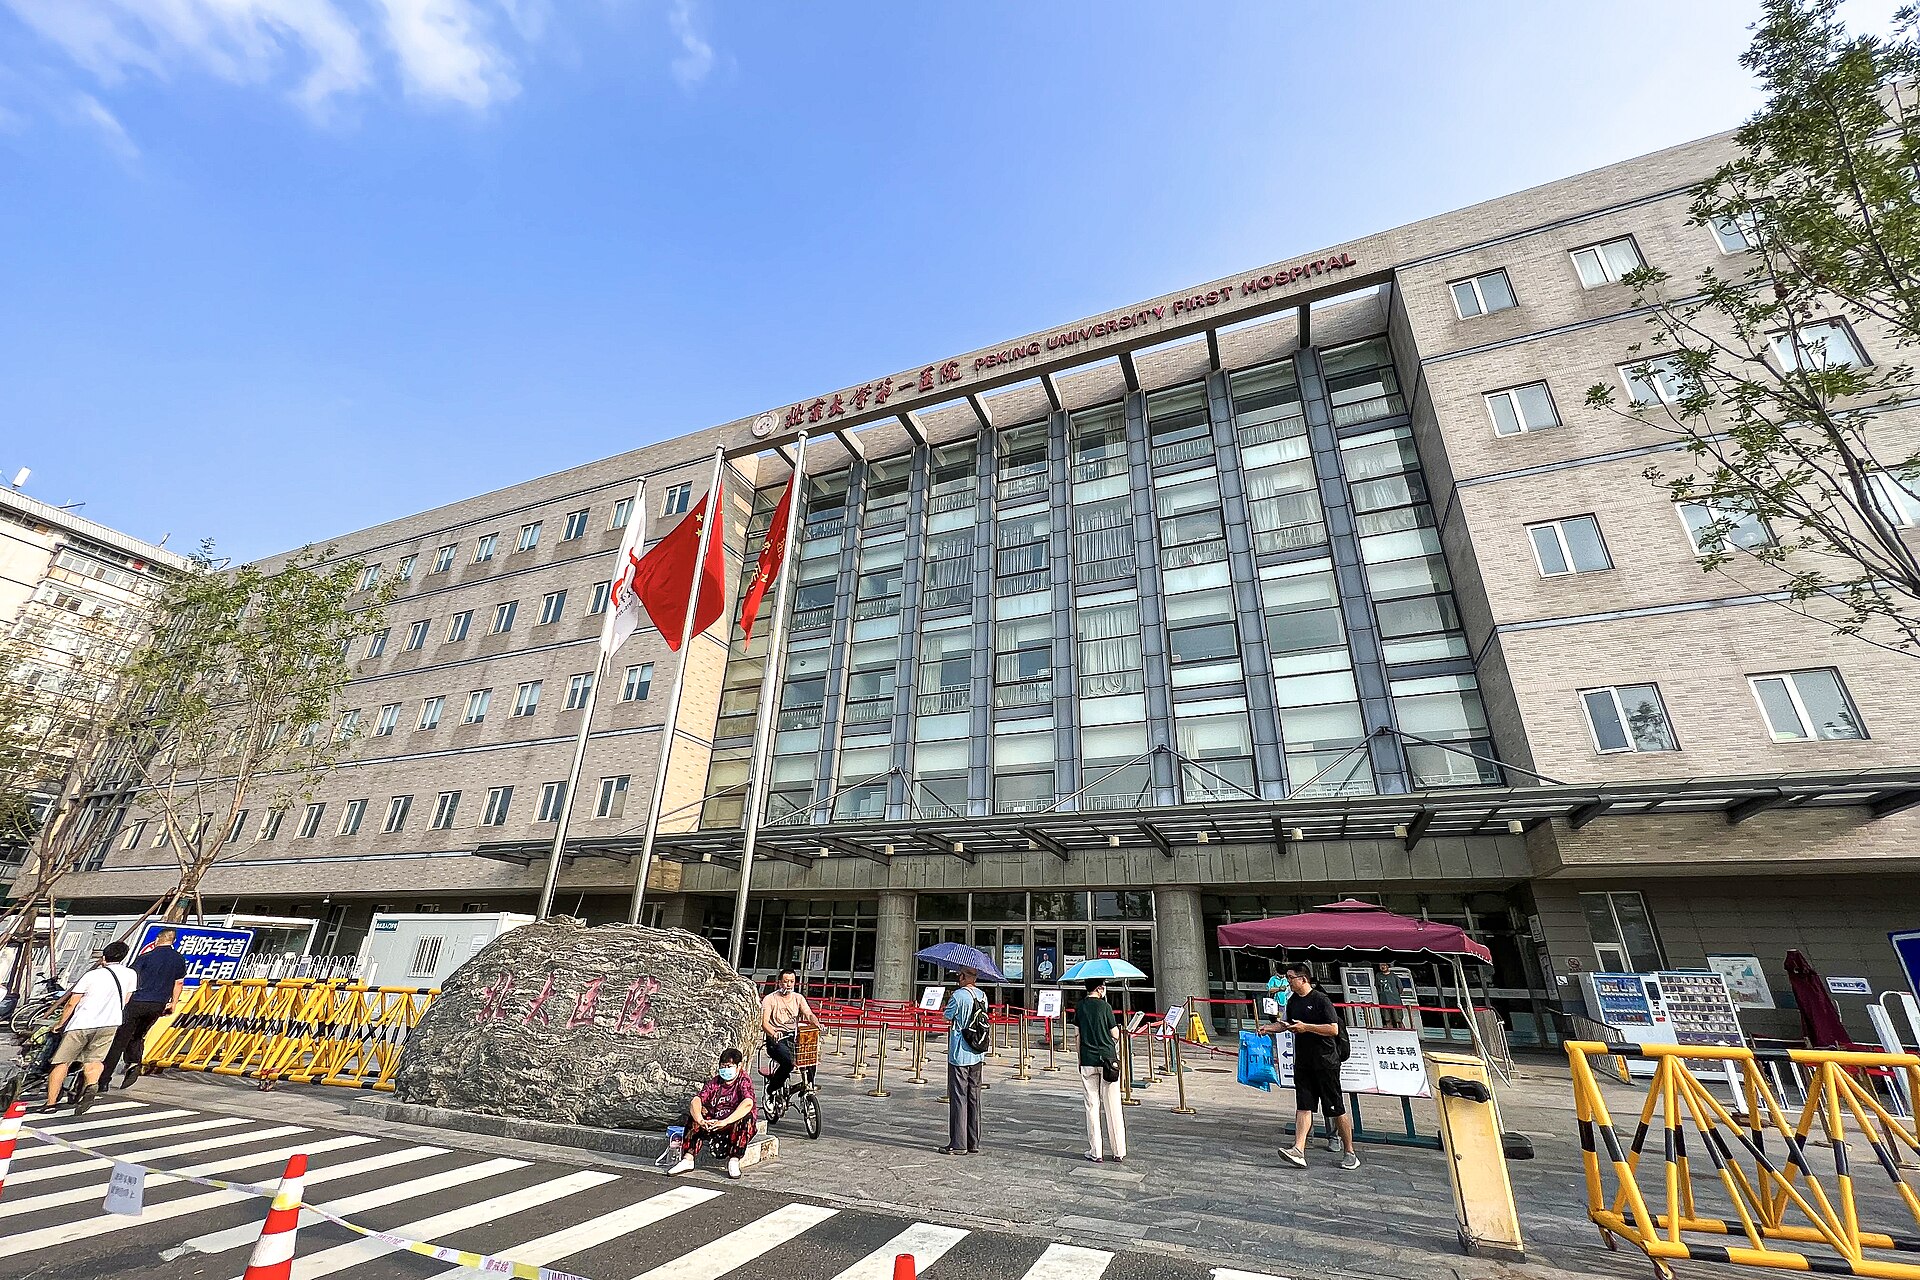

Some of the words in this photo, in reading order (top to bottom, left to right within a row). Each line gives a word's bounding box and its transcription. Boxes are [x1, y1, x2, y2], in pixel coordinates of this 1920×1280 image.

[974, 342, 1041, 372] PEKING
[1046, 305, 1167, 351] UNIVERSITY
[1173, 286, 1233, 316] FIRST
[1241, 252, 1357, 297] HOSPITAL
[177, 934, 247, 958] 消防车道
[185, 959, 237, 980] 止占用
[476, 971, 661, 1034] 北大医院
[1376, 1045, 1417, 1057] 社会车辆
[1379, 1060, 1420, 1072] 禁止入内
